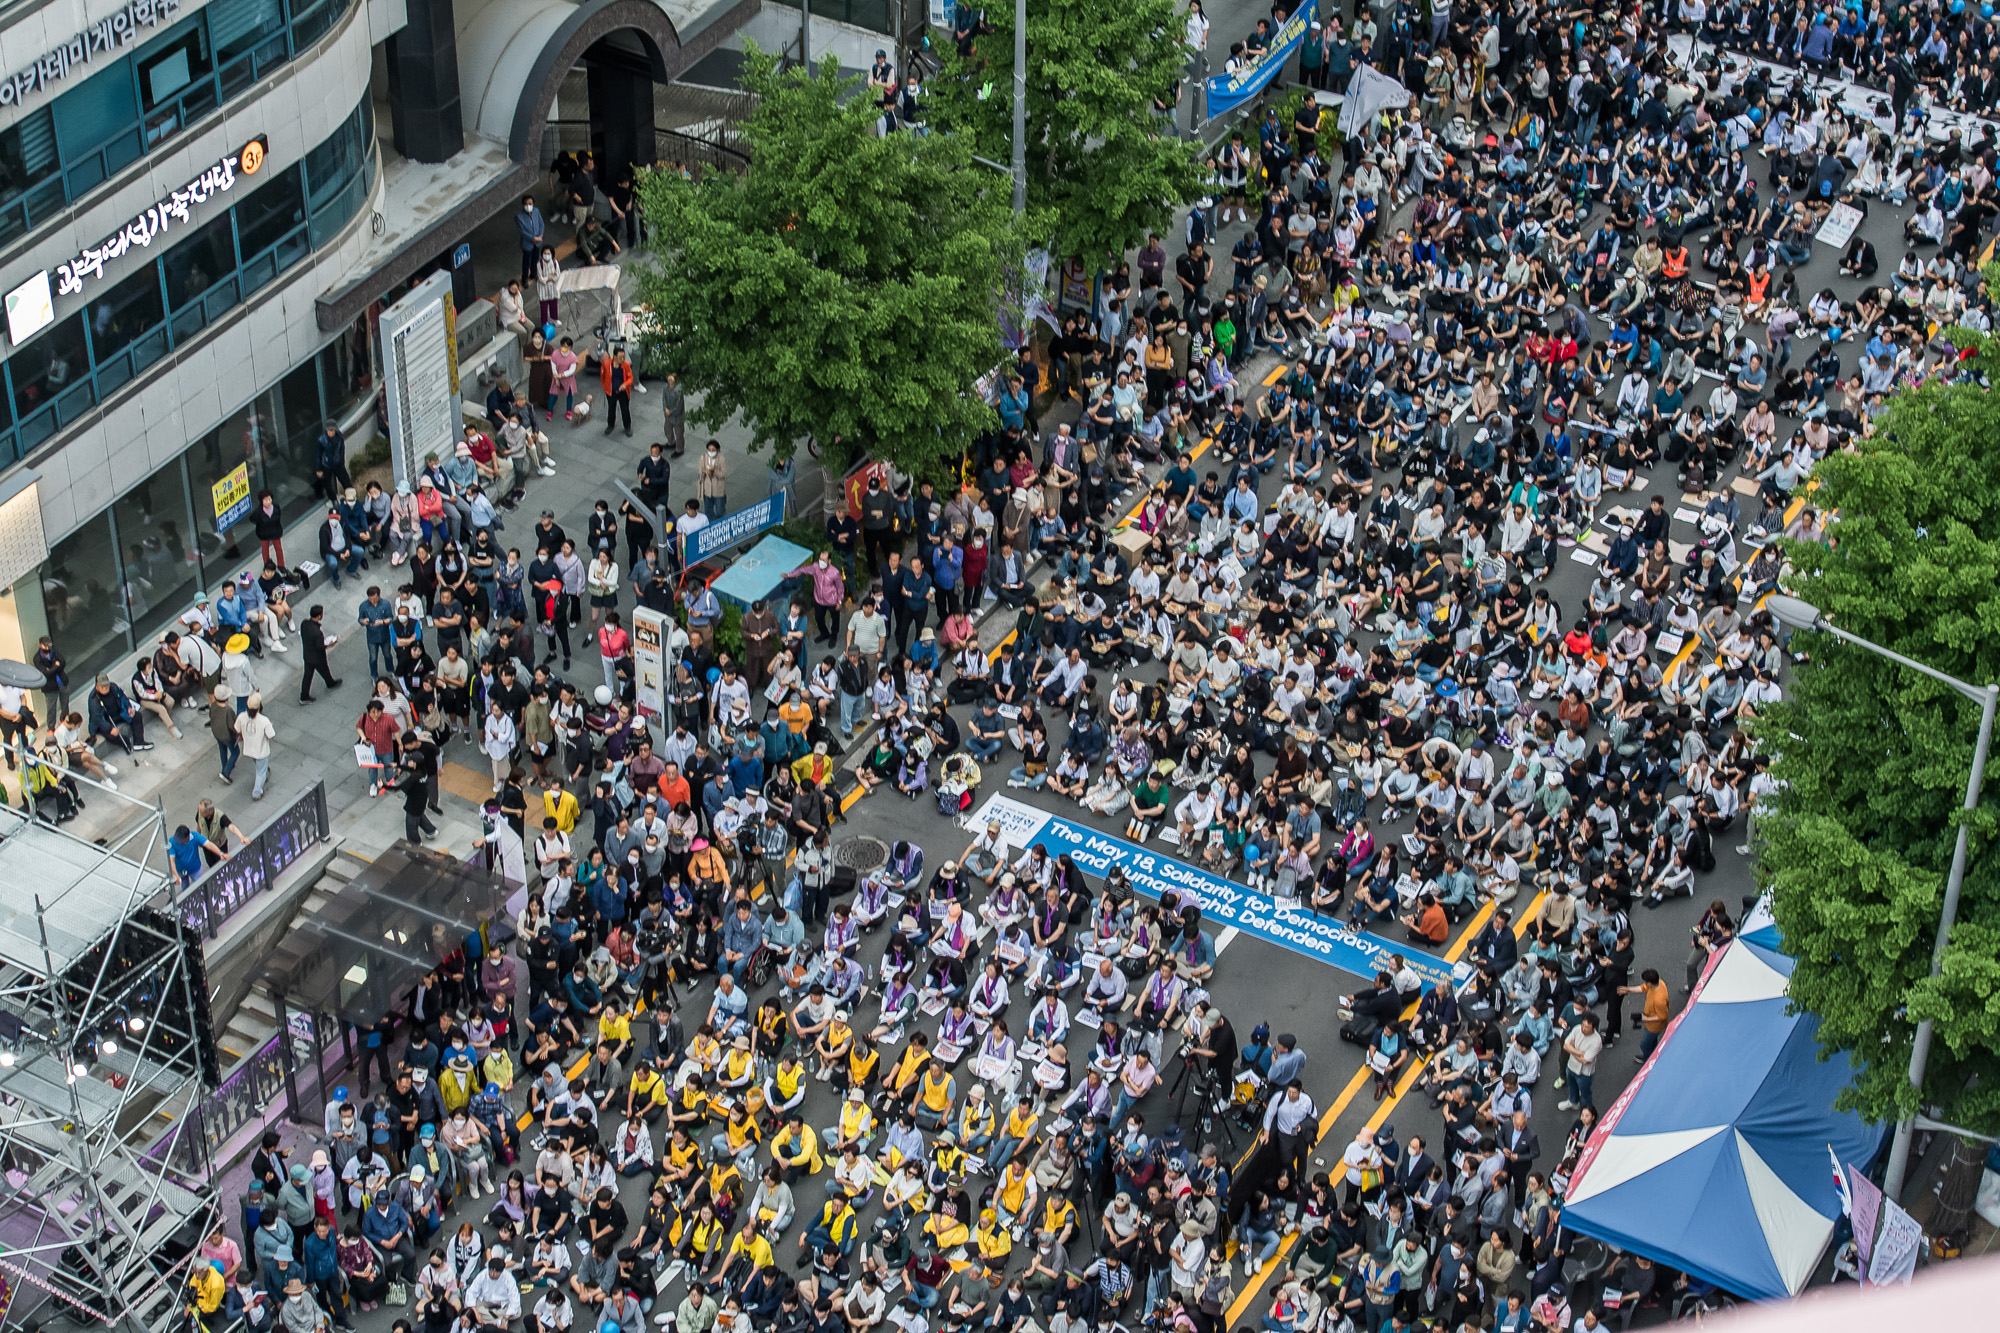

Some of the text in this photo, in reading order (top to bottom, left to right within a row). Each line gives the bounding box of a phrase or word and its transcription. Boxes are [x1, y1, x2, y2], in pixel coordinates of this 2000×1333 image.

[57, 156, 238, 295] 광주여성가족재단
[1050, 821, 1083, 844] The
[1085, 835, 1128, 860] May
[1132, 853, 1155, 874] 18,
[1159, 863, 1243, 904] Solidarity
[1244, 895, 1272, 914] for
[1274, 908, 1380, 955] Democracy
[1070, 849, 1111, 870] and
[1238, 909, 1333, 954] Defenders
